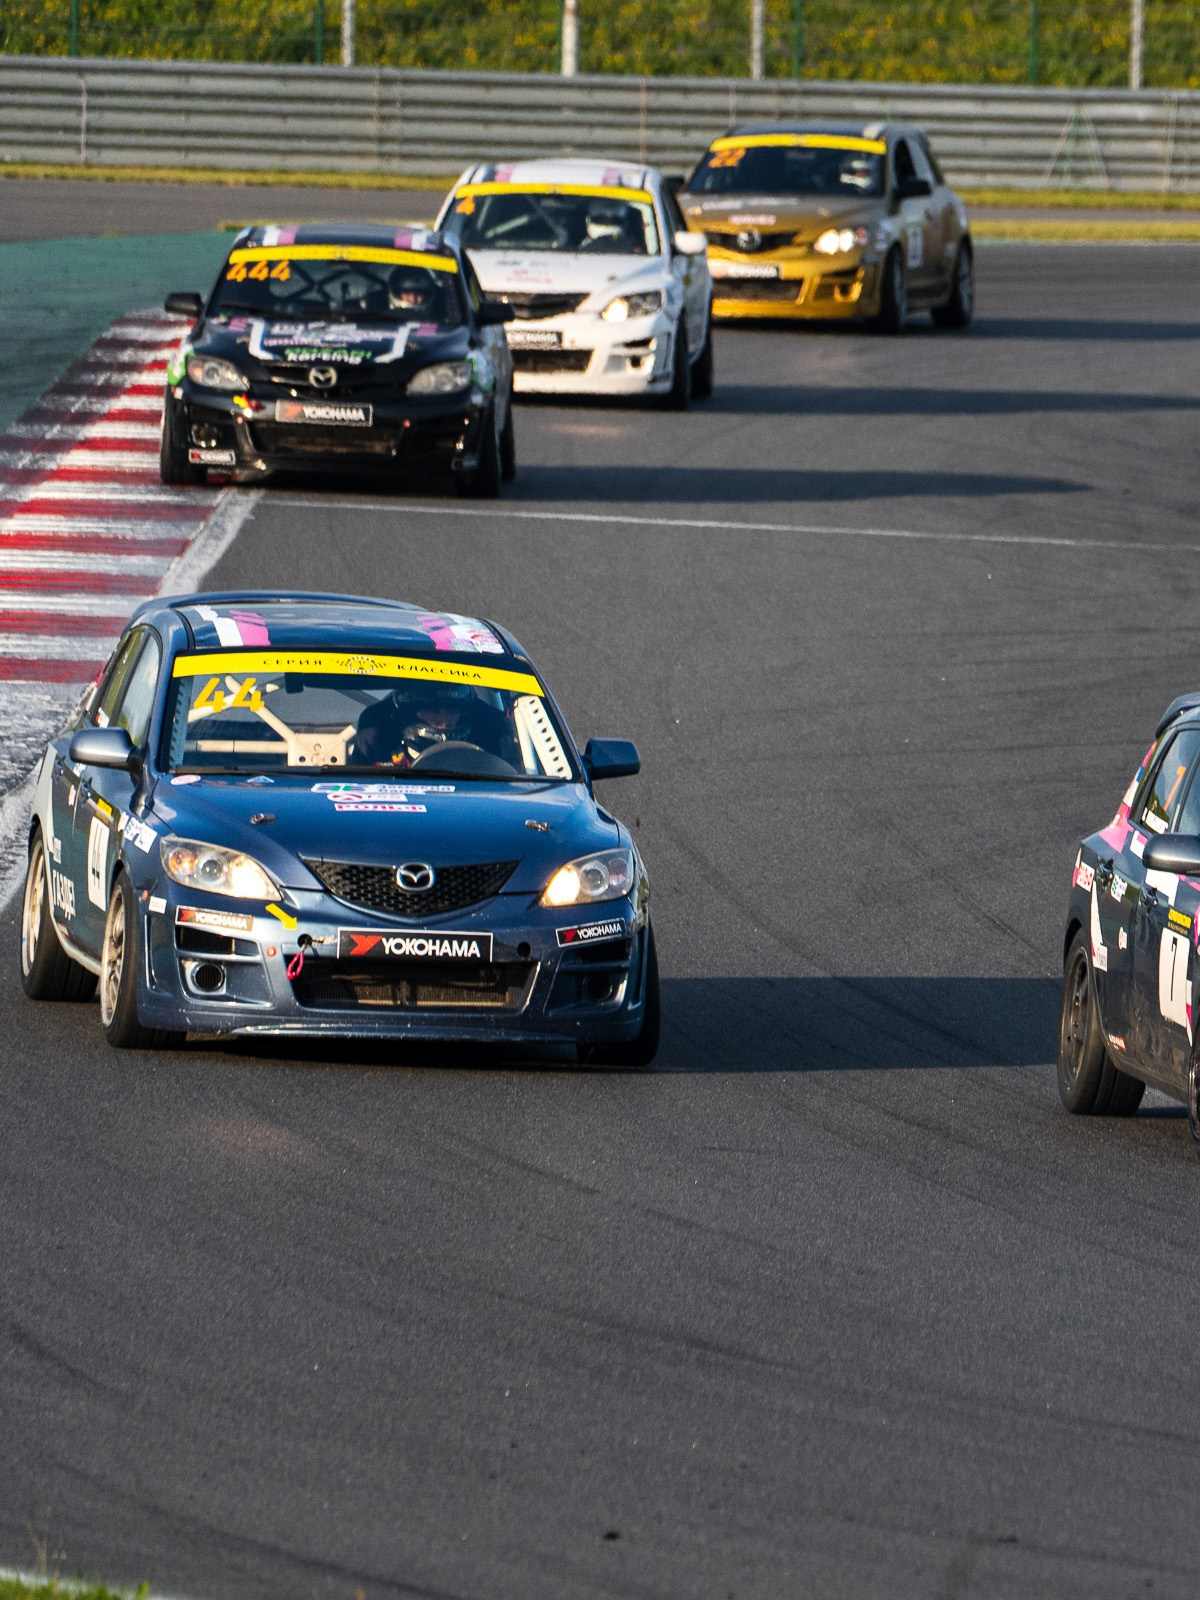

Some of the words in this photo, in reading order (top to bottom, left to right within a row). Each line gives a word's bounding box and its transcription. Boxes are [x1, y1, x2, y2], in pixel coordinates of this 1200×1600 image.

[226, 259, 291, 282] 444
[303, 405, 365, 421] YOKOHAMA
[397, 664, 482, 679] КЛАССИКА
[193, 677, 265, 712] 44
[195, 911, 248, 930] YOKOHAMA
[576, 922, 622, 939] YOKOHAMA
[381, 937, 481, 958] YOKOHAMA
